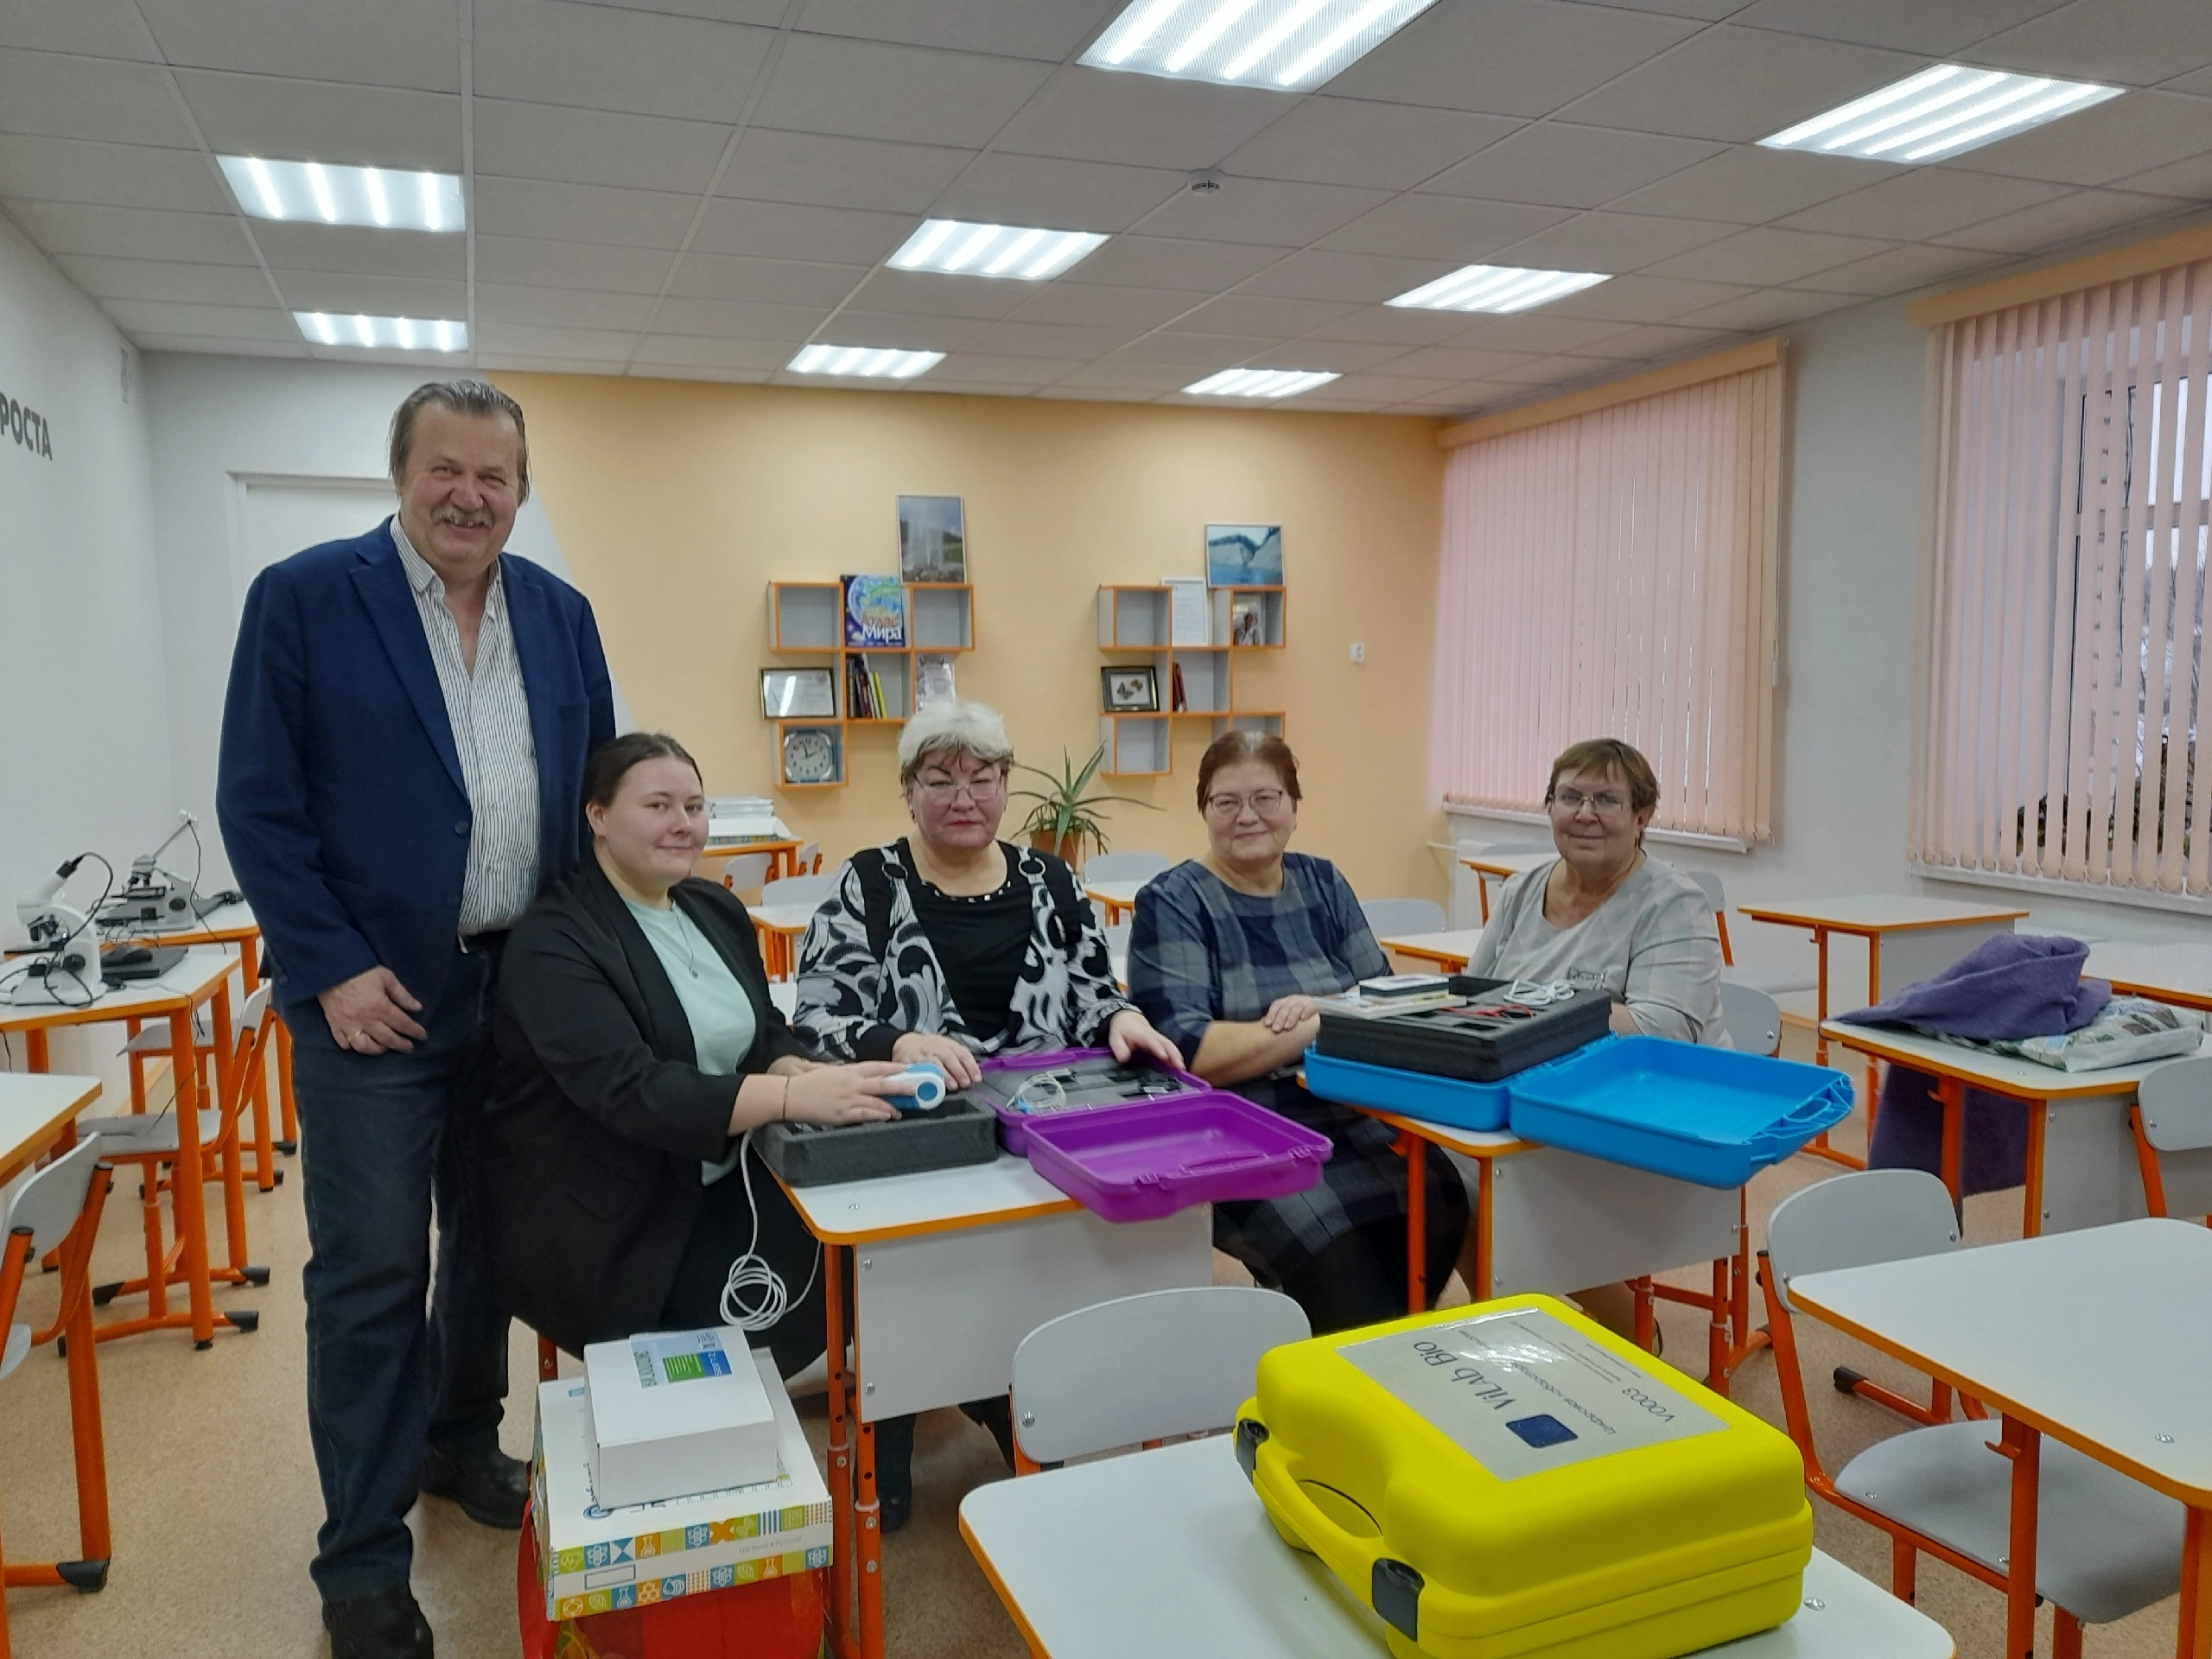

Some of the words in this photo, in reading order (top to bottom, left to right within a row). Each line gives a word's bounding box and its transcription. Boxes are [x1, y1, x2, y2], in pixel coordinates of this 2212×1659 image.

[0, 391, 53, 461] РОСТА
[862, 624, 902, 645] Мира
[1414, 1341, 1458, 1366] Bio
[1622, 1388, 1675, 1422] V0003
